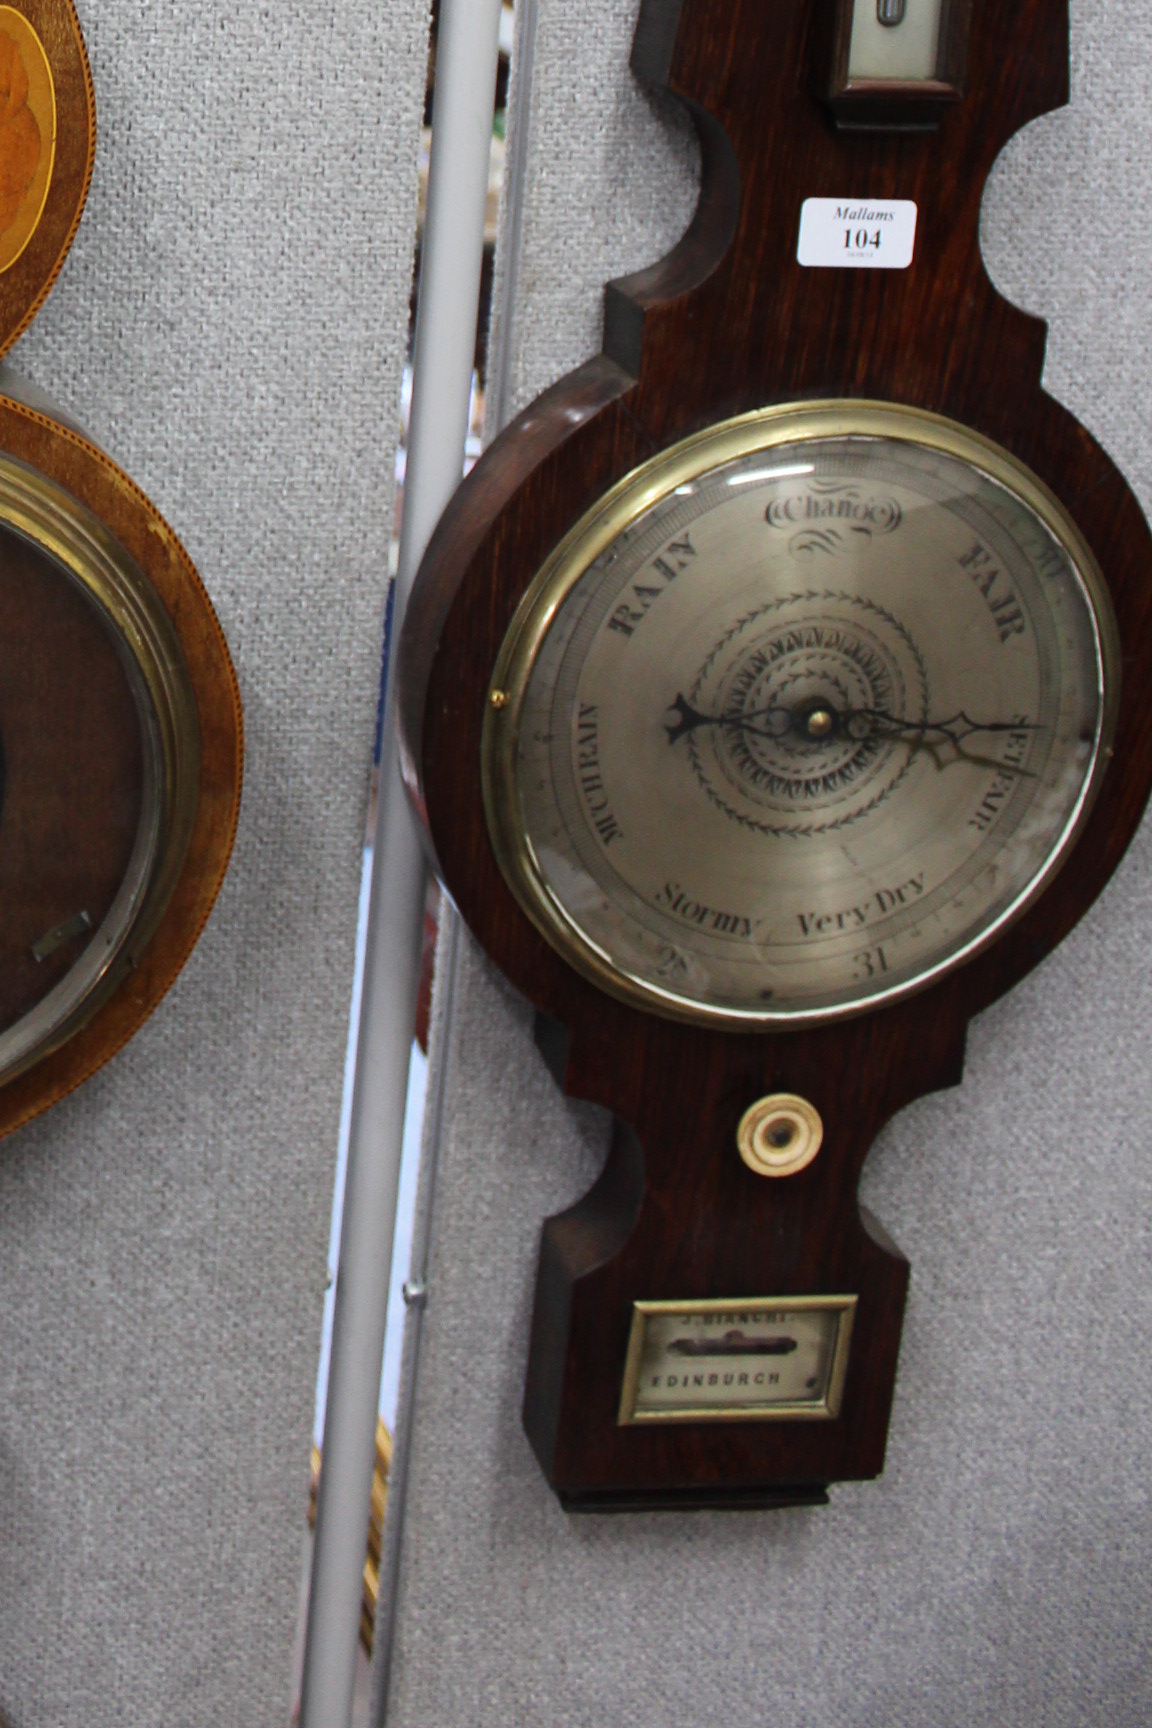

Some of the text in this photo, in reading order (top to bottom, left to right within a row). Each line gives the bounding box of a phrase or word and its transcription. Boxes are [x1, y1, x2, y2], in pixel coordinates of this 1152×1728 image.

[833, 206, 895, 221] Mallams
[843, 228, 881, 250] 104
[608, 532, 697, 638] RAIN
[959, 537, 1025, 644] FAIR
[578, 703, 598, 770] RAIN
[969, 771, 1015, 832] FAIR
[655, 881, 762, 937] Stormy
[798, 903, 870, 939] Very
[875, 872, 925, 914] Dry
[852, 945, 889, 981] 31
[650, 1373, 780, 1388] EDINBURGH
